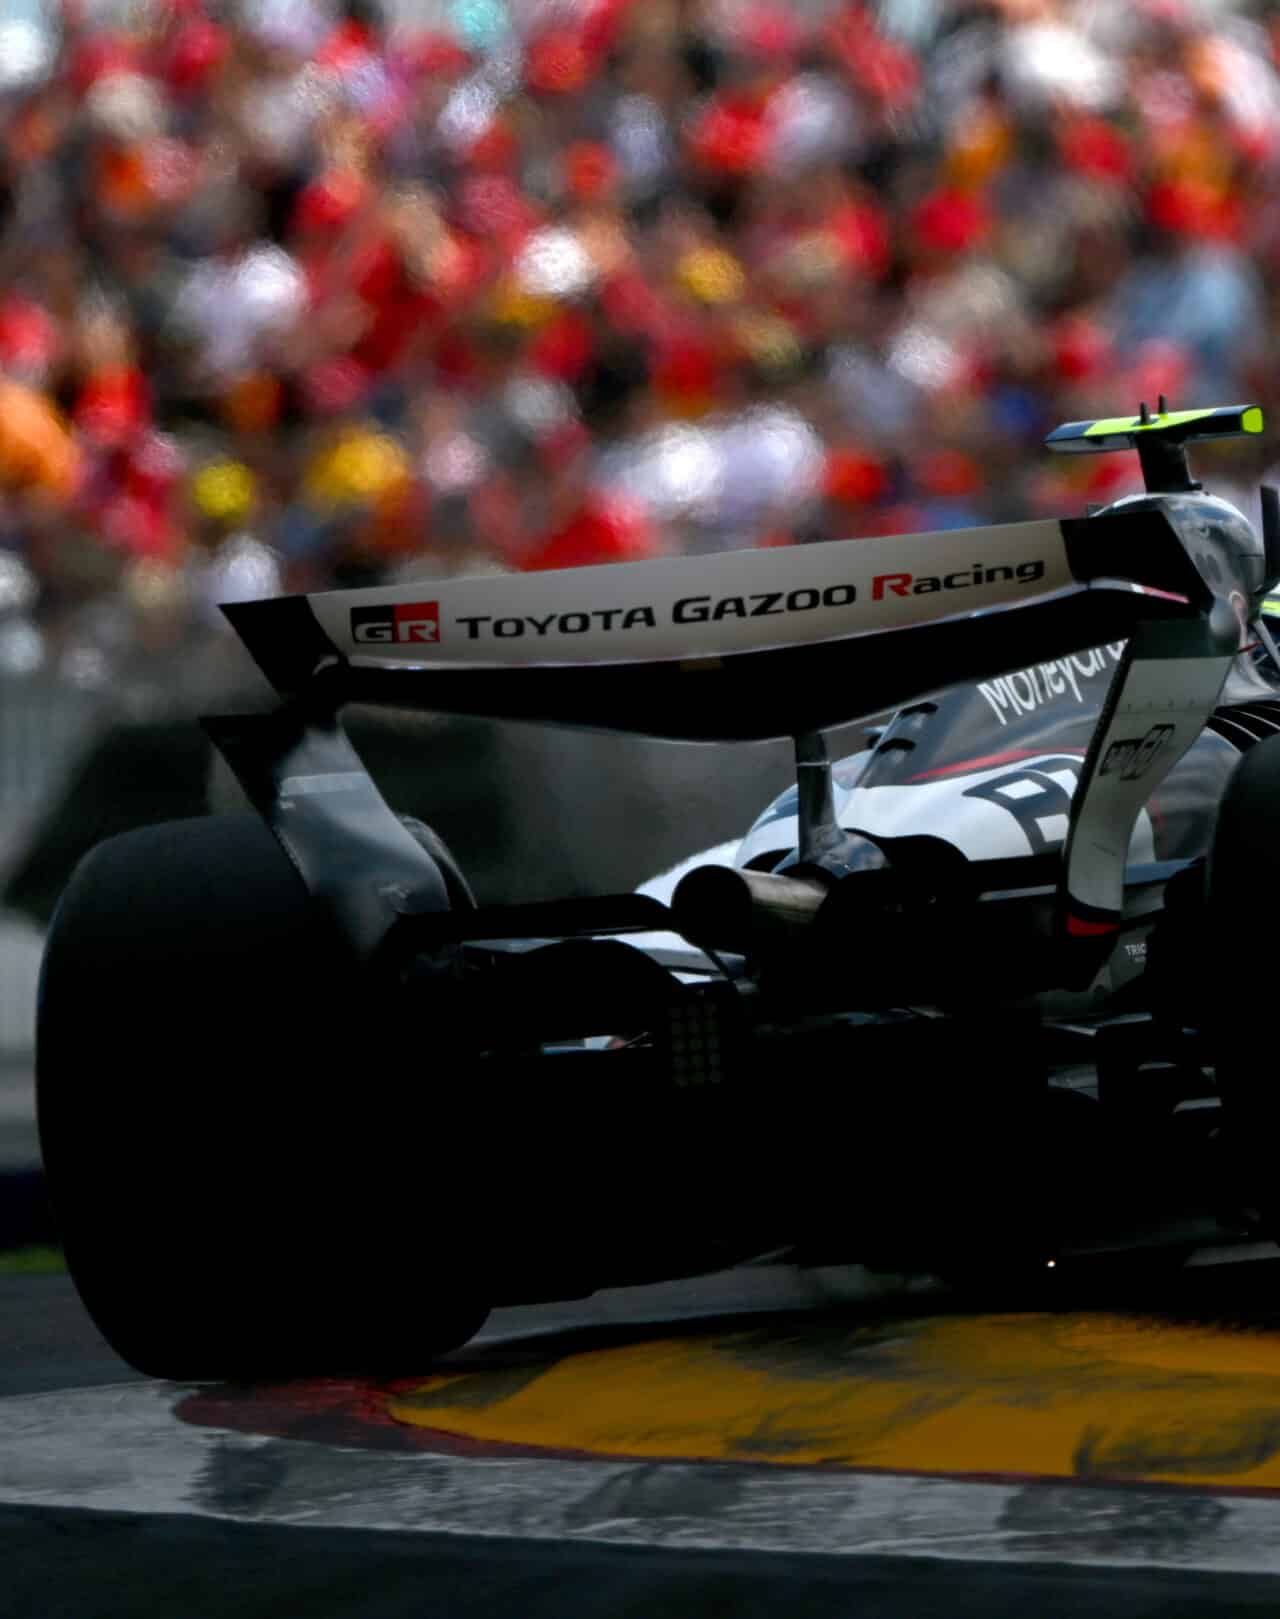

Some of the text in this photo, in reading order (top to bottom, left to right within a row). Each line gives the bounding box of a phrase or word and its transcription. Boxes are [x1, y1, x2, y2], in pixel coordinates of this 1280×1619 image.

[455, 559, 1044, 640] TOYOTA GAZOO Racing
[352, 618, 440, 644] GR
